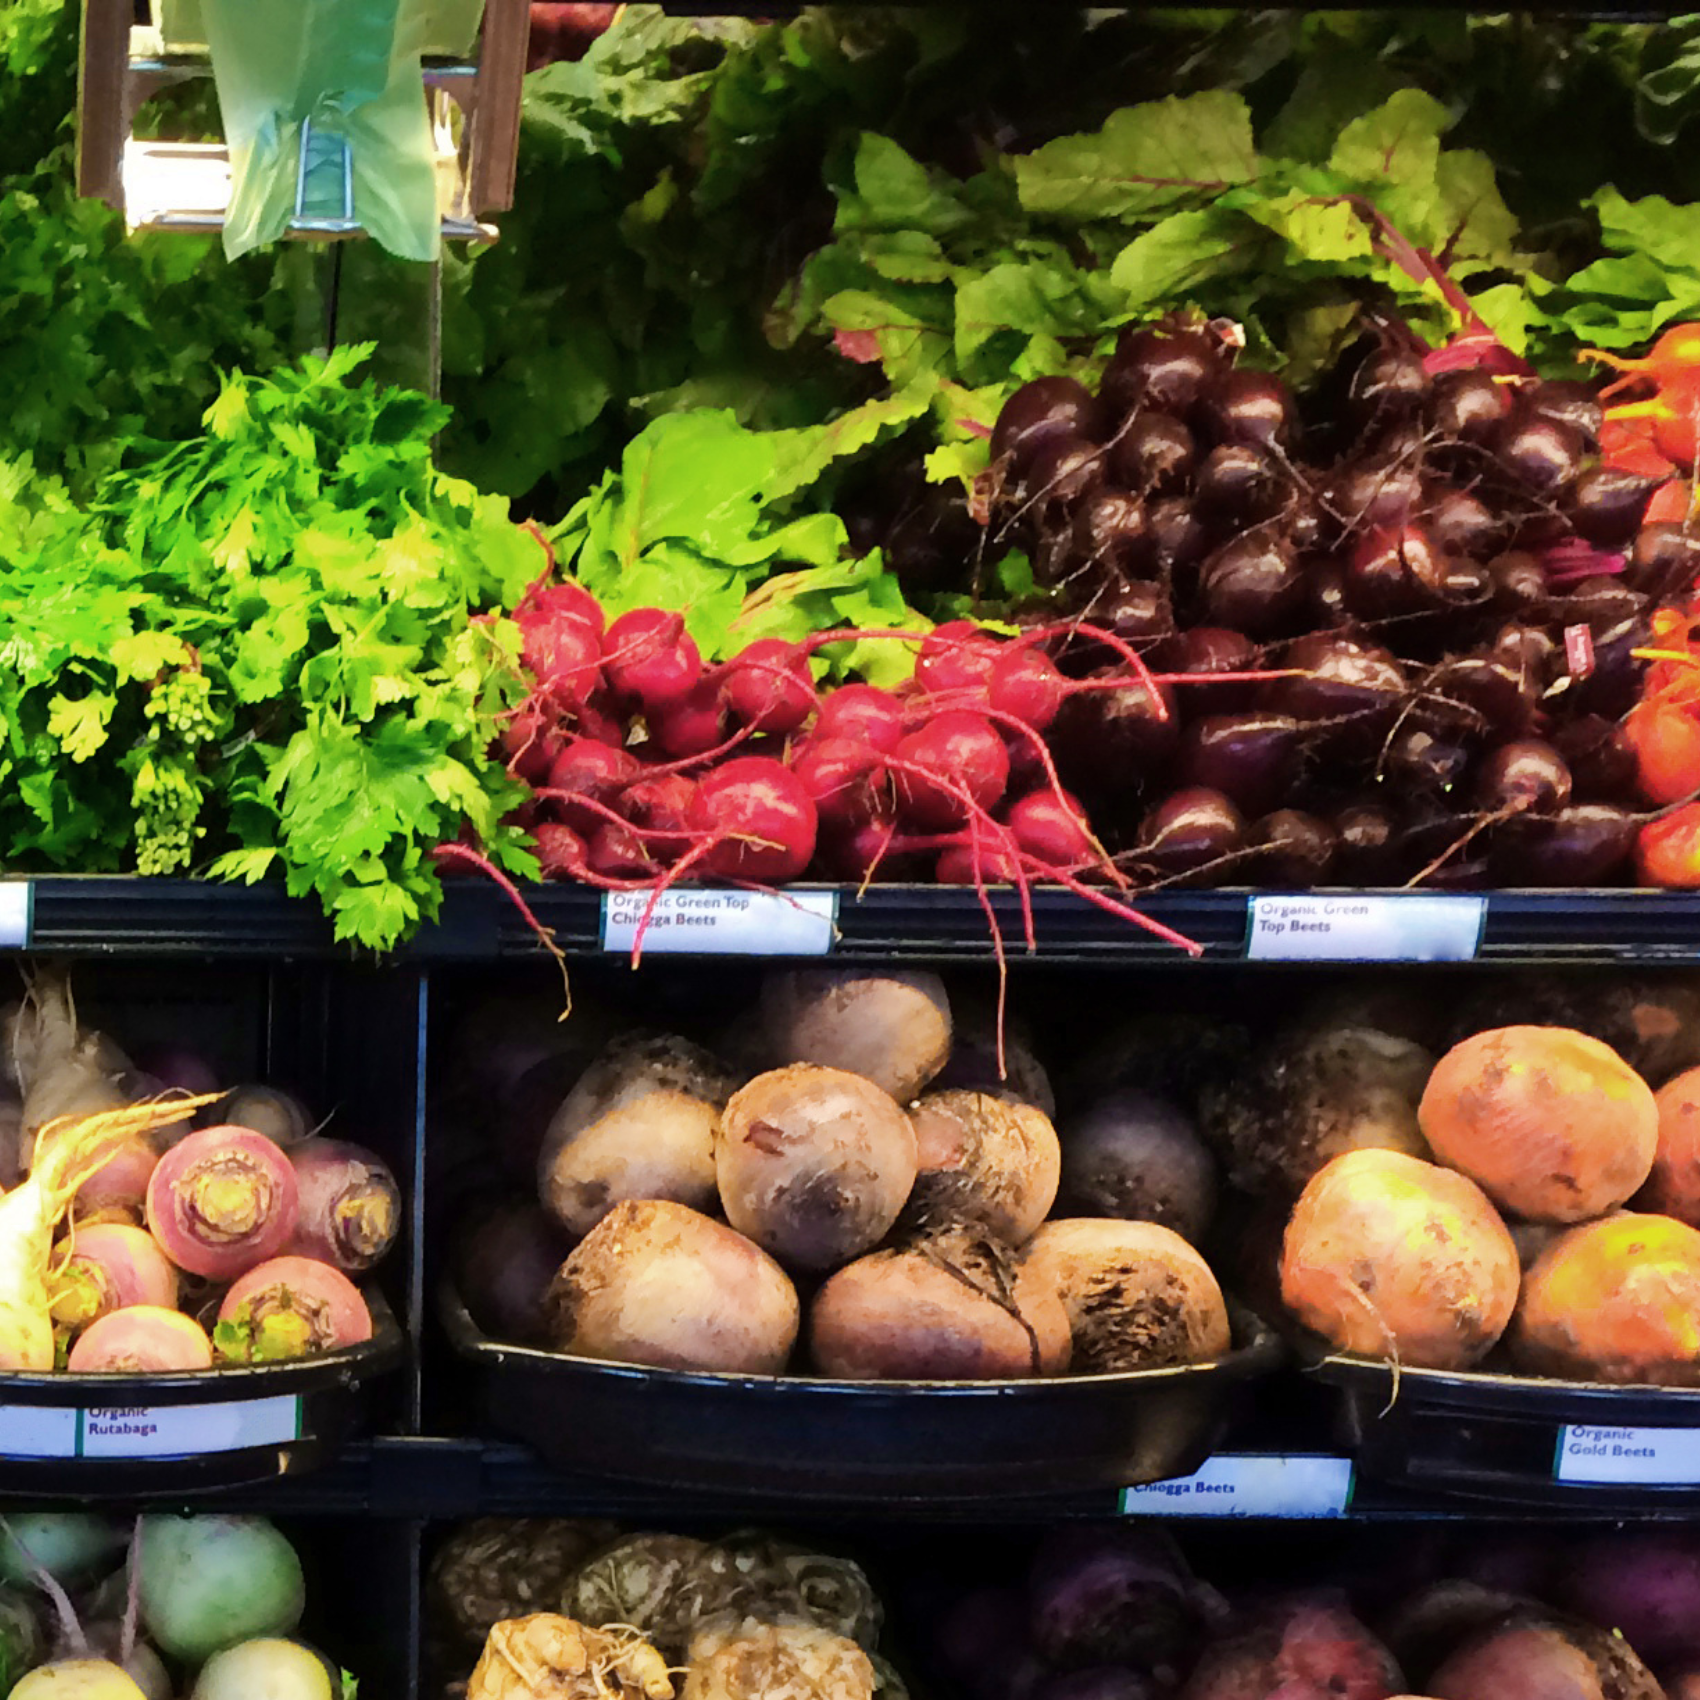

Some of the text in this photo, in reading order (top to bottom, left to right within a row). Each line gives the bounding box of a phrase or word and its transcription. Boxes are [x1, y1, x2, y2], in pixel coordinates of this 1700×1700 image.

[613, 894, 750, 911] Orgaic Green Top
[1324, 903, 1369, 915] Green
[675, 913, 717, 926] Beets
[1260, 920, 1331, 935] Top Beets
[89, 1408, 148, 1420] Organic
[88, 1423, 157, 1436] Rutabaga
[1571, 1425, 1634, 1442] Organic
[1569, 1443, 1655, 1457] Gold Beets
[1195, 1482, 1235, 1493] Beets
